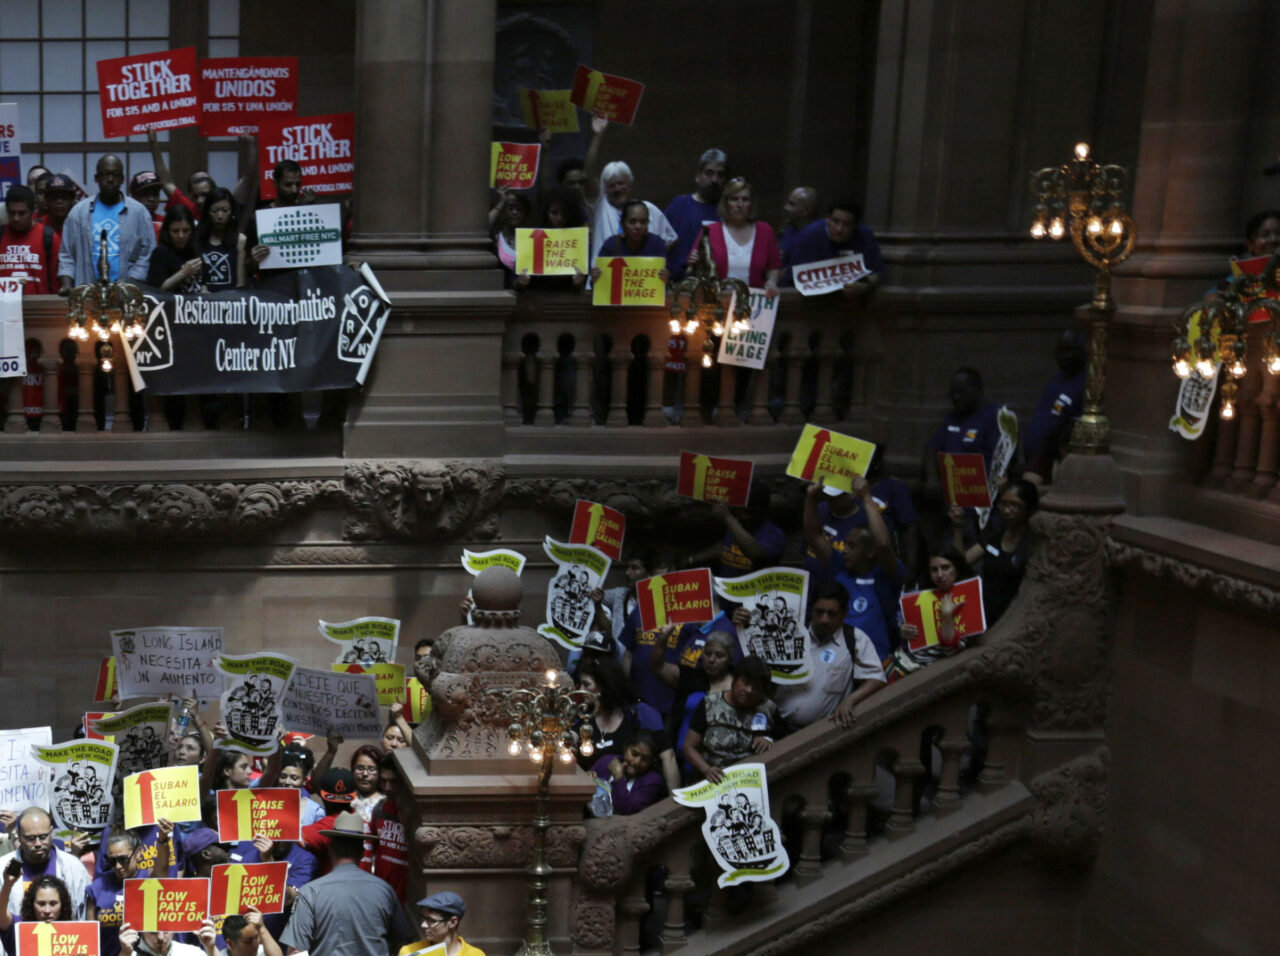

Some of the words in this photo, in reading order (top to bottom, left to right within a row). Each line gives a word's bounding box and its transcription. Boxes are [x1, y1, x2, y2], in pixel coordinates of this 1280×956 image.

[122, 58, 174, 83] STICK
[202, 65, 290, 80] MANTENGÁMONOS
[106, 74, 192, 102] TOGETHER
[215, 79, 276, 99] UNIDOS
[282, 122, 334, 147] STICK
[266, 139, 352, 164] TOGETHER
[499, 153, 523, 163] LOW
[544, 239, 578, 249] RAISE
[545, 249, 565, 259] THE
[545, 258, 578, 269] WAGE
[624, 268, 658, 278] RAISE
[796, 260, 863, 286] CITIZEN
[624, 278, 645, 288] THE
[624, 288, 657, 299] WAGE
[173, 293, 247, 325] Restaurant
[249, 287, 337, 335] Opportunities
[726, 328, 768, 346] LIVING
[215, 338, 260, 372] Center
[263, 337, 279, 371] of
[278, 336, 298, 370] NY
[724, 341, 765, 360] WAGE
[823, 444, 860, 462] SUBAN
[820, 454, 833, 464] EL
[707, 468, 738, 480] RAISE
[706, 484, 730, 495] NEW
[664, 582, 700, 595] SUBAN
[731, 580, 757, 592] MAKE
[757, 575, 774, 587] THE
[775, 574, 803, 586] ROAD
[664, 593, 677, 603] EL
[665, 600, 711, 612] SALARIO
[141, 634, 174, 651] LONG
[177, 634, 223, 652] ISLAND
[139, 654, 202, 670] NECESITA
[45, 749, 69, 759] MAKE
[69, 745, 88, 755] THE
[89, 745, 113, 758] ROAD
[153, 780, 189, 791] SUBAN
[154, 790, 167, 800] EL
[155, 798, 198, 809] SALARIO
[252, 800, 284, 811] RAISE
[252, 809, 267, 820] UP
[252, 819, 279, 829] NEW
[159, 891, 188, 902] LOW
[159, 912, 185, 922] NOT
[187, 911, 205, 922] OK
[53, 934, 80, 945] LOW
